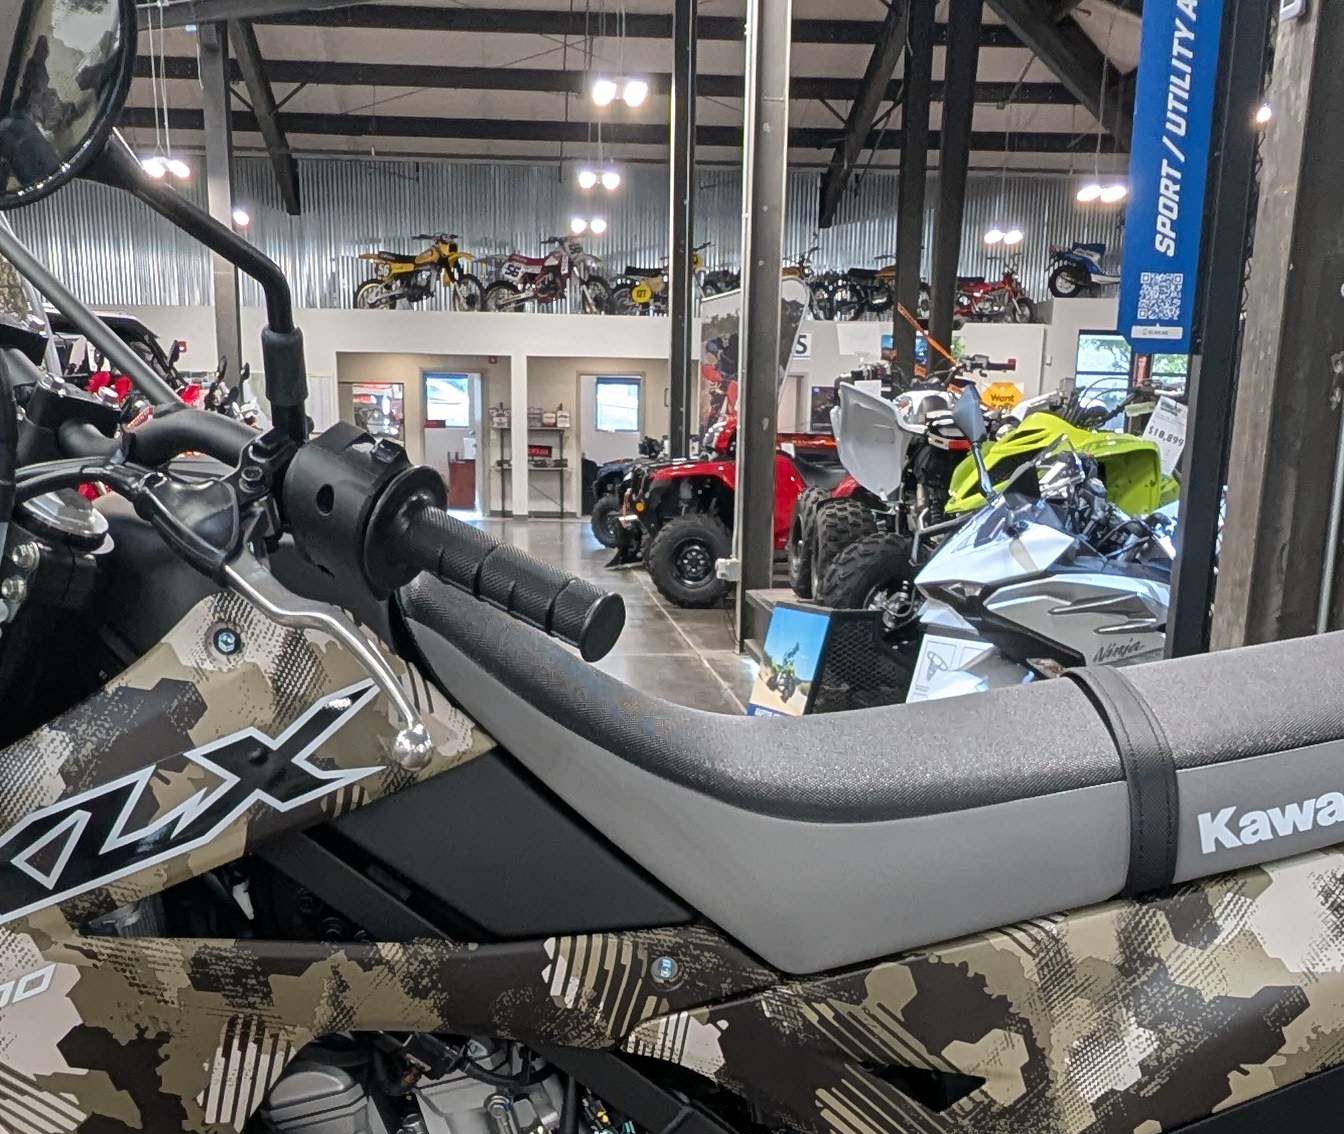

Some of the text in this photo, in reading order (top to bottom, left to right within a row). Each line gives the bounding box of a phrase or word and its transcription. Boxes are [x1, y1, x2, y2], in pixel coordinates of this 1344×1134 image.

[1166, 17, 1196, 137] UTILITY
[1155, 159, 1183, 258] SPORT
[1093, 637, 1145, 662] Ninja
